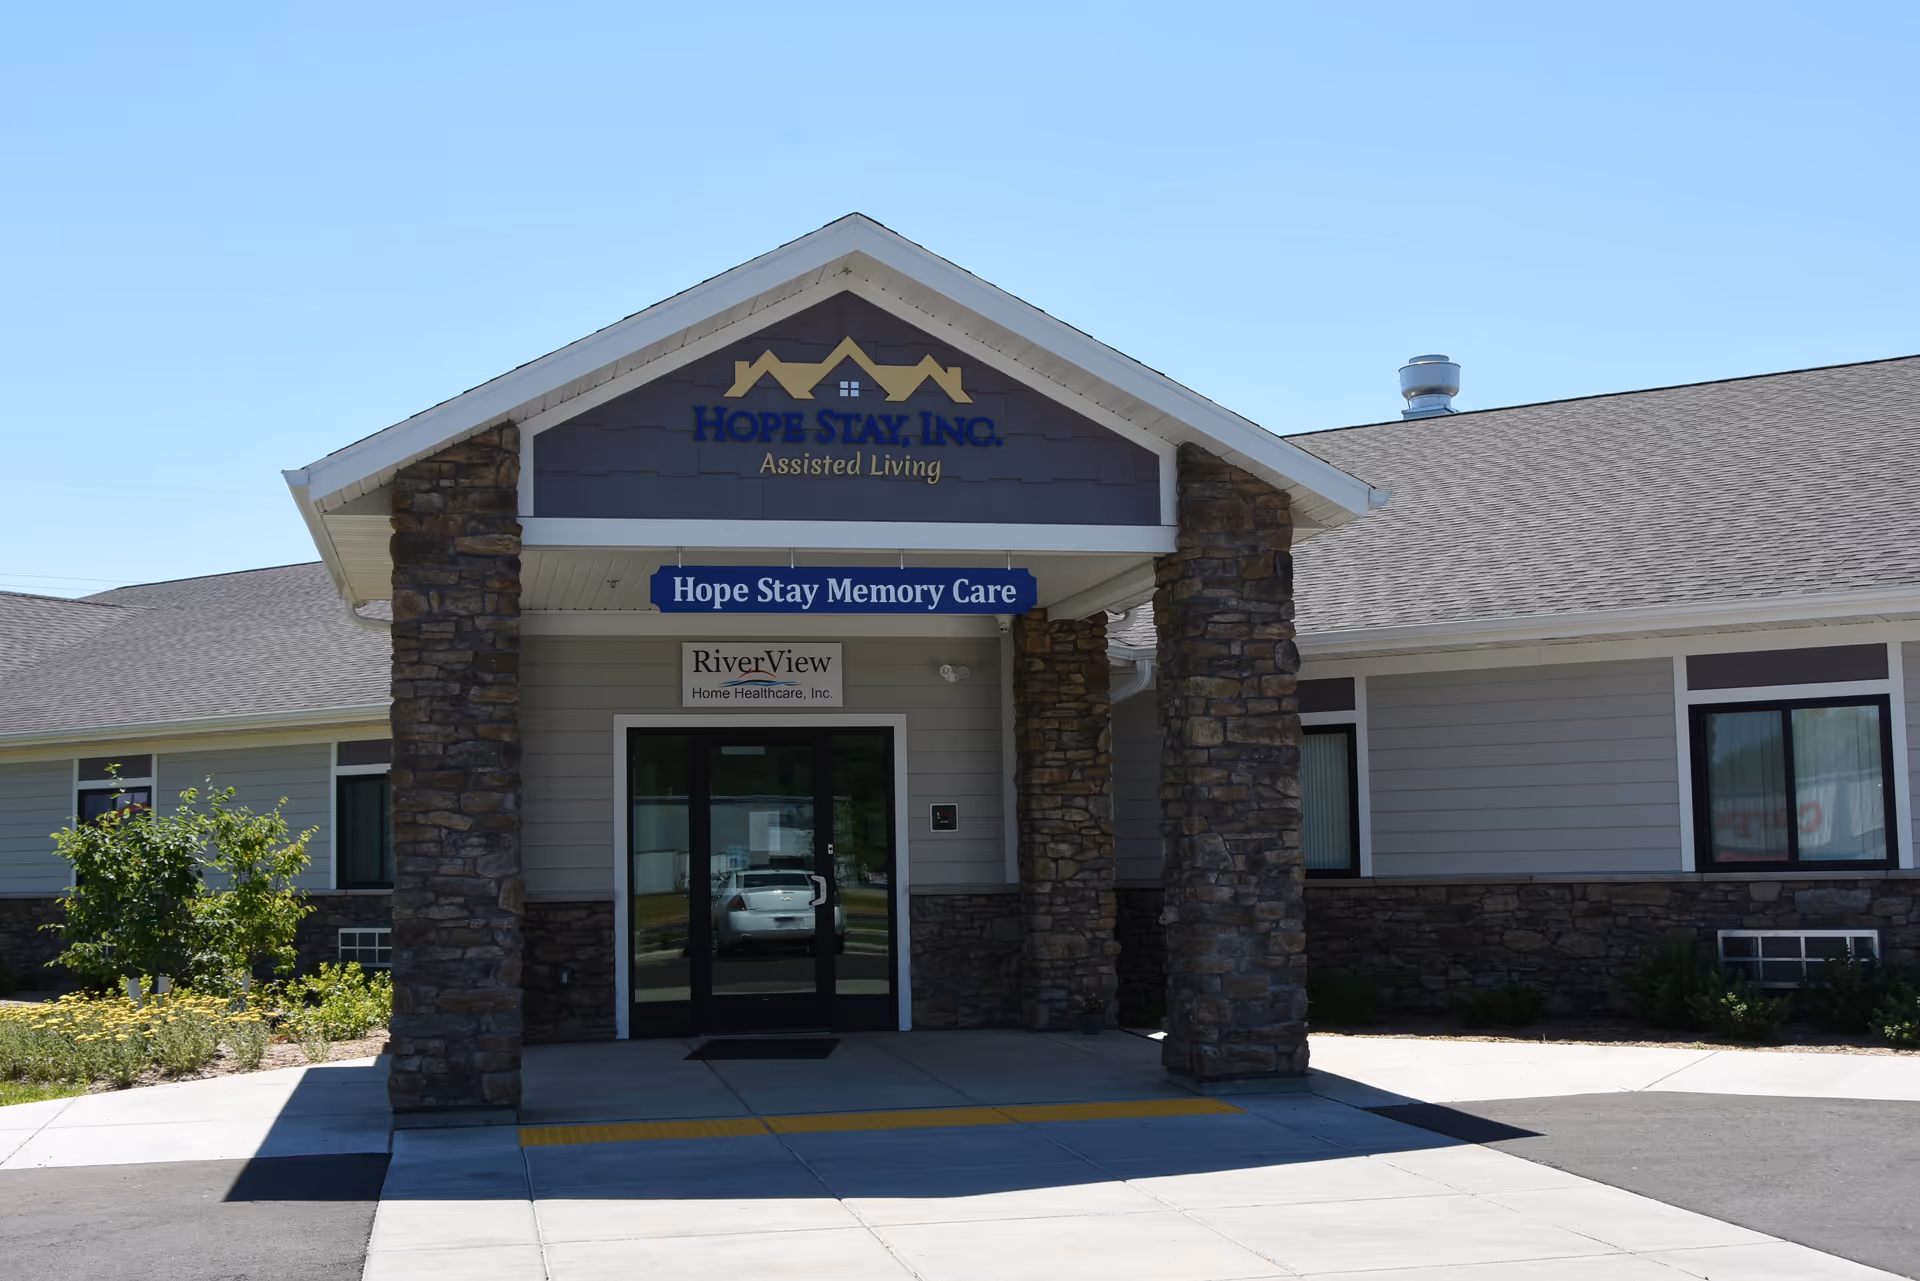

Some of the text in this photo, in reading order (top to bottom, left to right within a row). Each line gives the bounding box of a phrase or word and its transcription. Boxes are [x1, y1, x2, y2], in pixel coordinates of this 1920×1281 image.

[693, 405, 1004, 448] HOPE STAY, INC.
[760, 451, 942, 485] Assisted Living
[673, 576, 1017, 610] Hope Stay Memory Care
[692, 649, 832, 674] RiverView
[692, 687, 833, 701] Home Healthcare, Inc.
